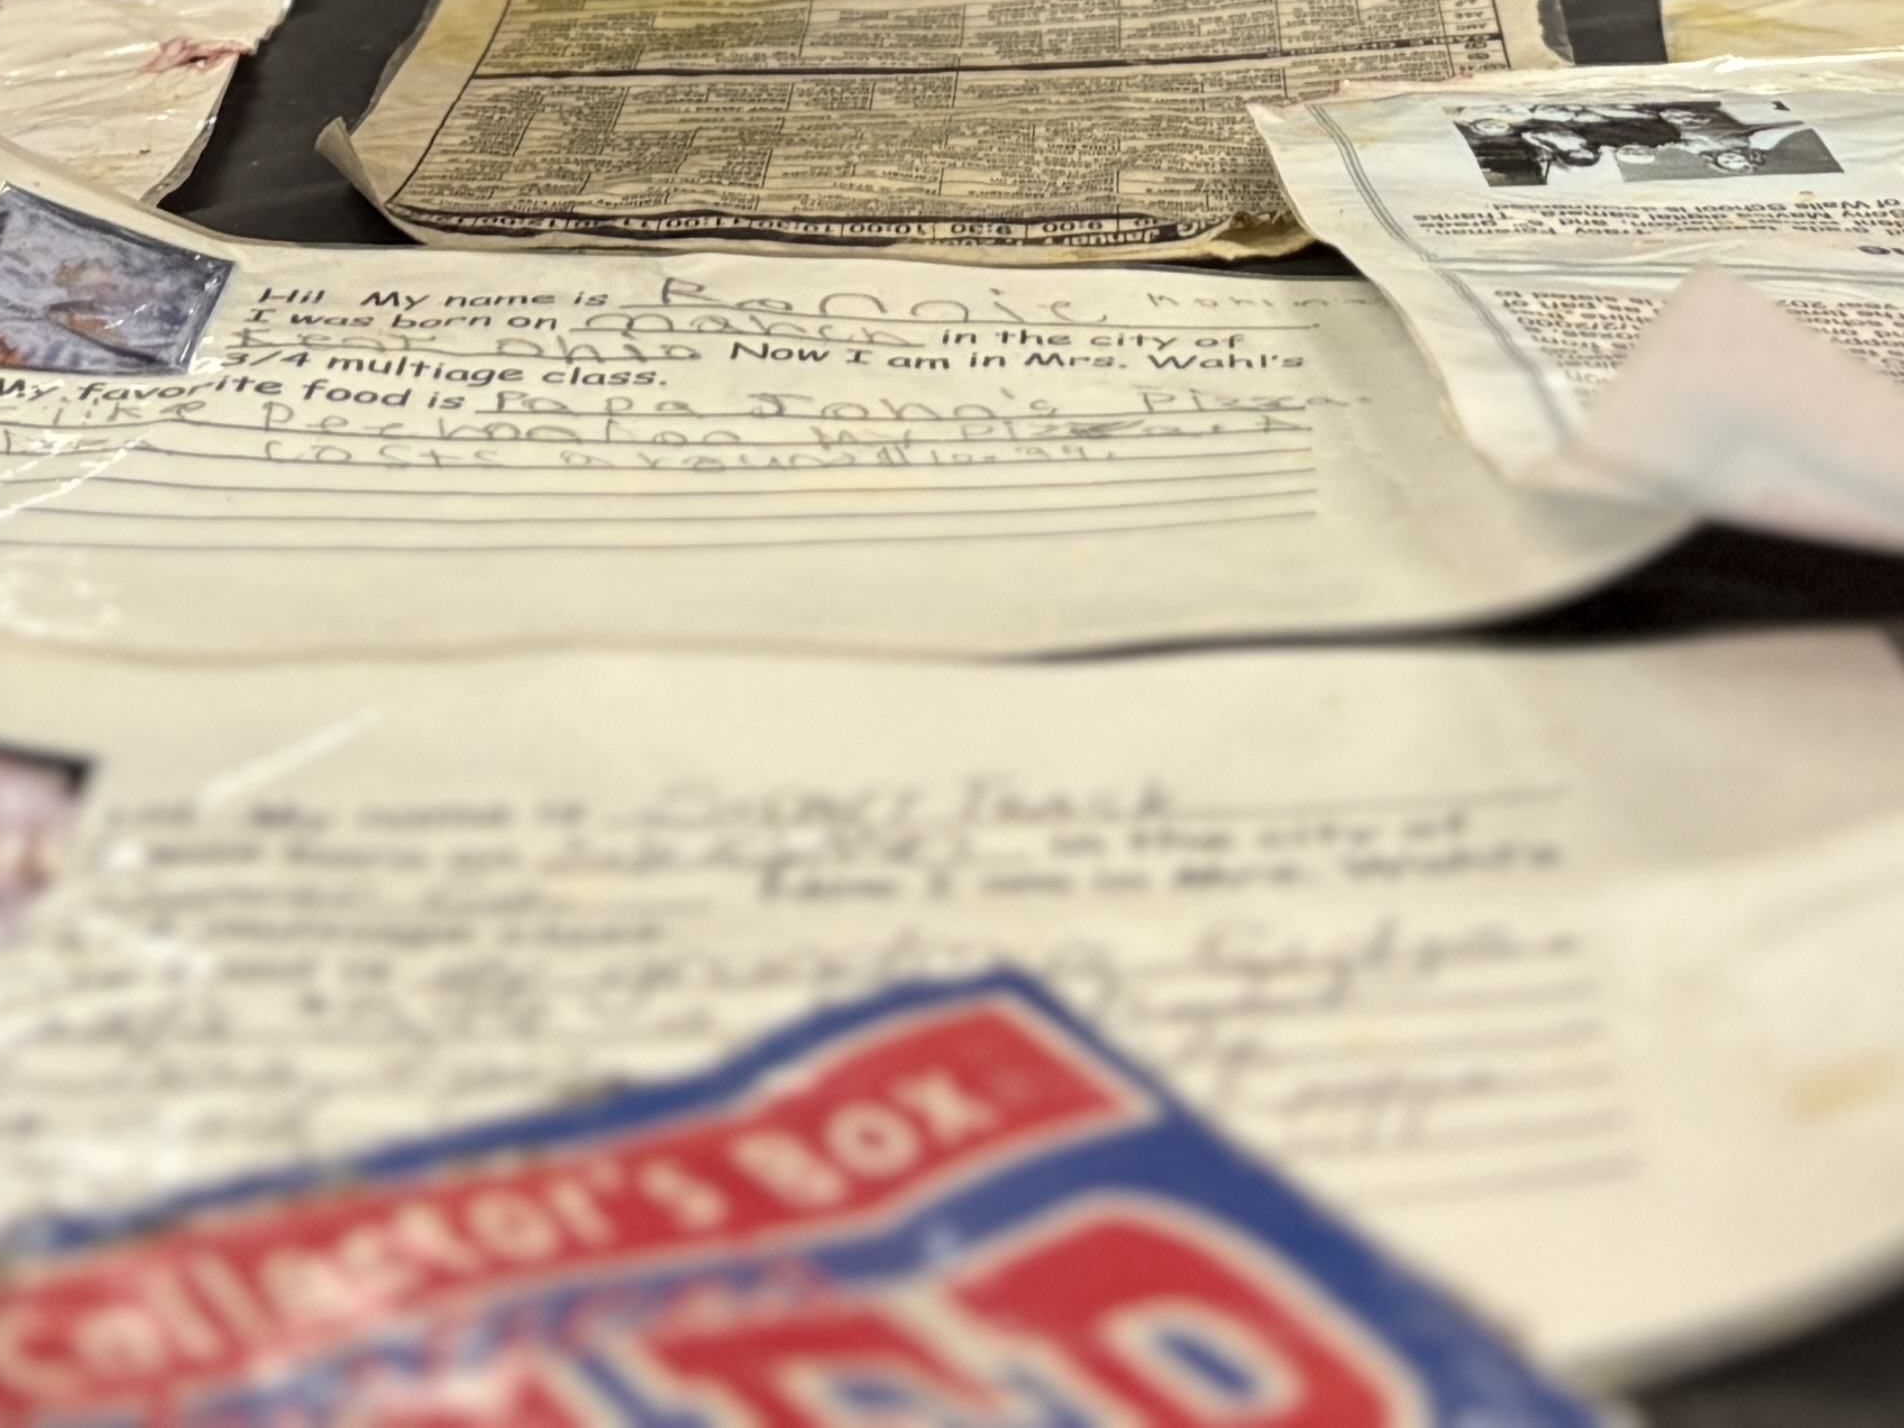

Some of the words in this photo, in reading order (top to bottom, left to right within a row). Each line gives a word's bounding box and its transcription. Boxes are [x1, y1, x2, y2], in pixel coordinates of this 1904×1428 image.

[1041, 220, 1104, 233] 9:00
[1413, 212, 1509, 222] Thanks
[849, 223, 927, 235] 10:00
[951, 222, 1012, 234] 9:30
[359, 290, 433, 309] My
[443, 293, 557, 307] name
[574, 293, 610, 307] is
[243, 308, 276, 324] I
[289, 312, 378, 328] was
[389, 309, 492, 329] born
[506, 316, 559, 330] on
[939, 329, 979, 345] in
[995, 329, 1074, 346] the
[1087, 331, 1178, 350] city
[1193, 333, 1247, 348] of
[729, 341, 849, 364] Now
[844, 349, 872, 365] I
[886, 355, 951, 370] am
[968, 351, 1009, 368] in
[1023, 351, 1128, 370] Mrs.
[1146, 352, 1306, 370] Wahl's
[222, 350, 309, 368] 3/4
[326, 356, 526, 387] multiage
[541, 366, 668, 386] class.
[76, 375, 284, 401] favorite
[300, 379, 412, 407] food
[425, 389, 465, 410] is
